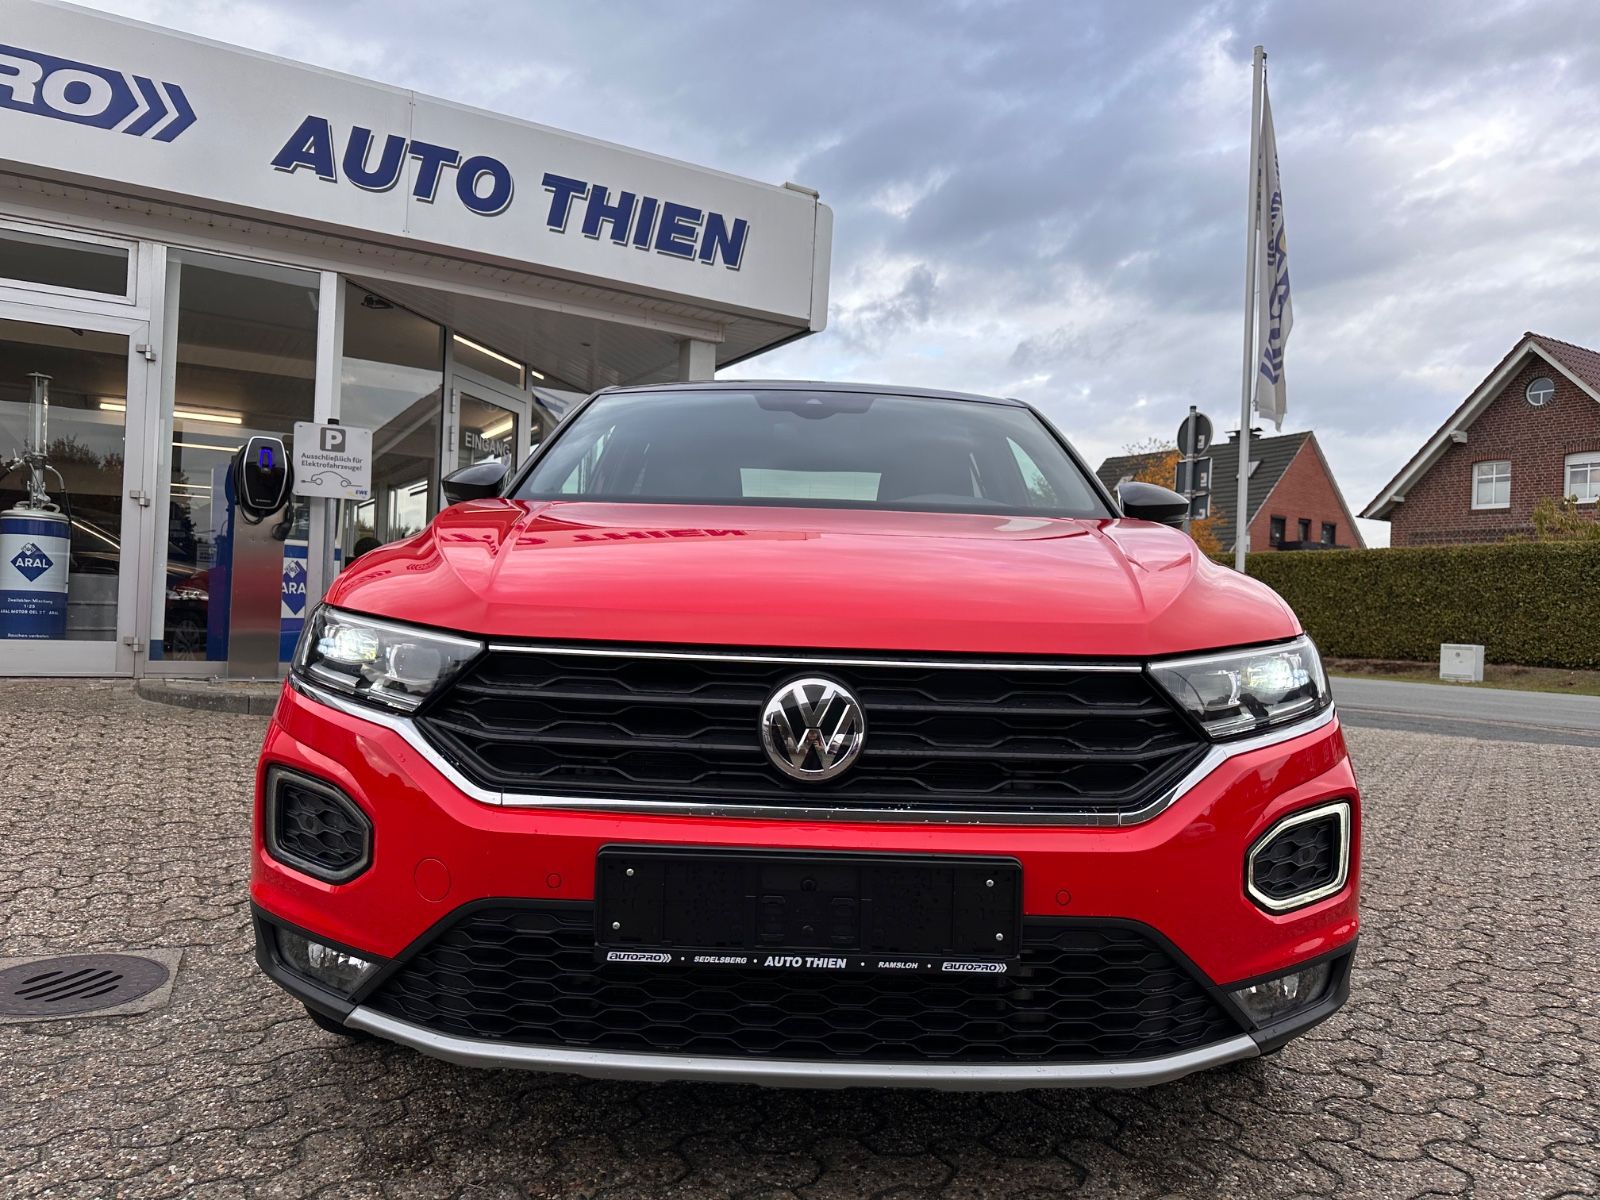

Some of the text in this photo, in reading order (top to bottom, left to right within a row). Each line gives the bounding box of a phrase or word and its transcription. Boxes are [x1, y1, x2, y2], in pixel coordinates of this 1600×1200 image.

[270, 115, 750, 271] AUTO THIEN
[325, 429, 343, 450] P
[465, 431, 511, 456] EINGANG
[301, 452, 363, 464] Ausschließlich für
[15, 557, 49, 568] ARAL
[694, 955, 748, 964] SEDELSBERG
[764, 956, 802, 967] AUTO
[805, 957, 847, 969] THIEN
[878, 961, 919, 969] RAMSLOH
